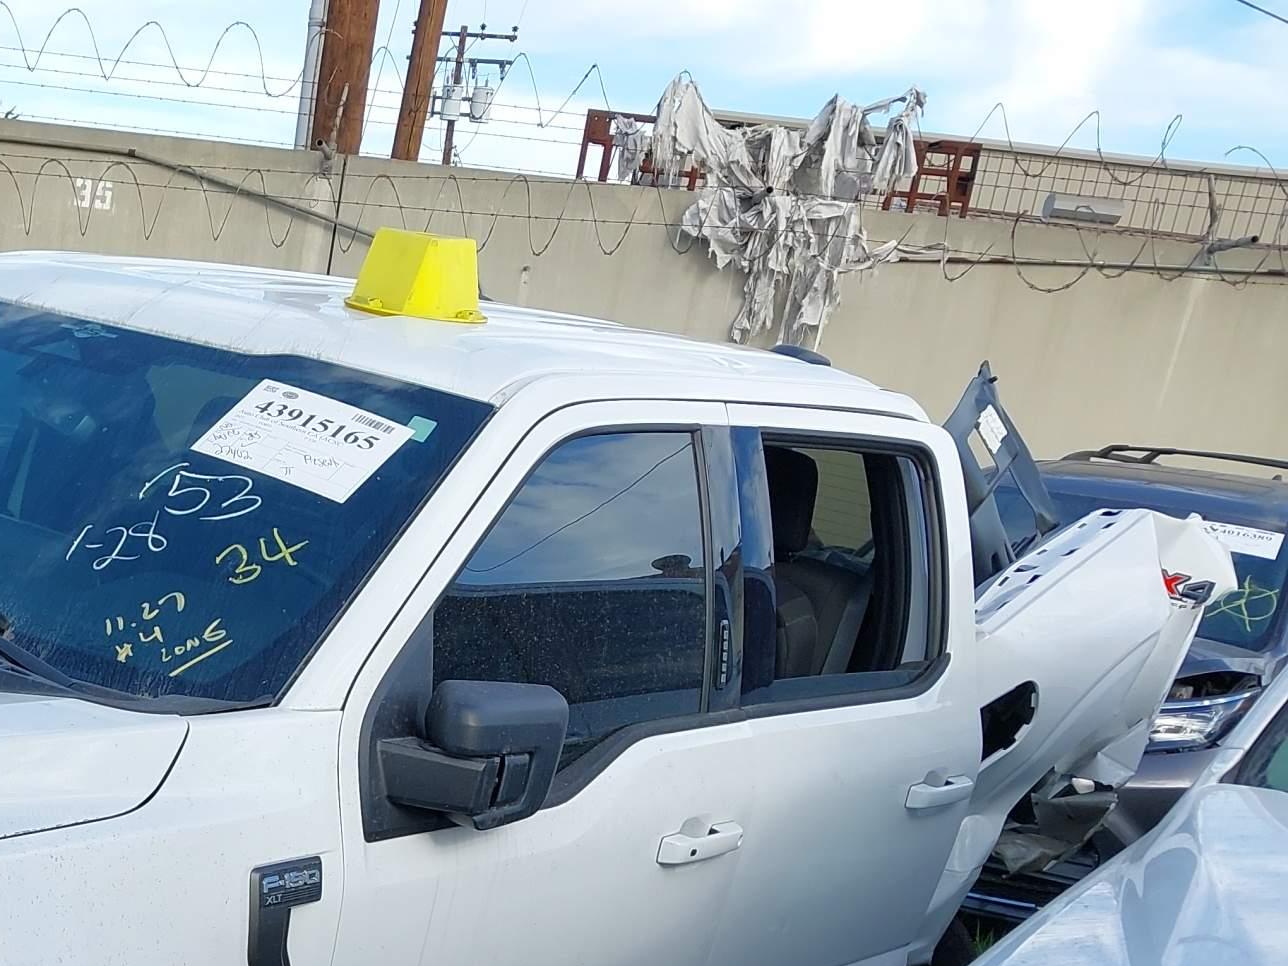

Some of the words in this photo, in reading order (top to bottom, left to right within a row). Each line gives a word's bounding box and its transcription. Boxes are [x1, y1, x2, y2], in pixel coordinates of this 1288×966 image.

[74, 177, 113, 209] 35
[254, 400, 381, 450] 43915165
[65, 510, 168, 571] 1-28
[215, 527, 310, 584] 34
[1161, 568, 1217, 605] X4
[262, 868, 321, 894] F-150
[264, 893, 283, 906] XLT
